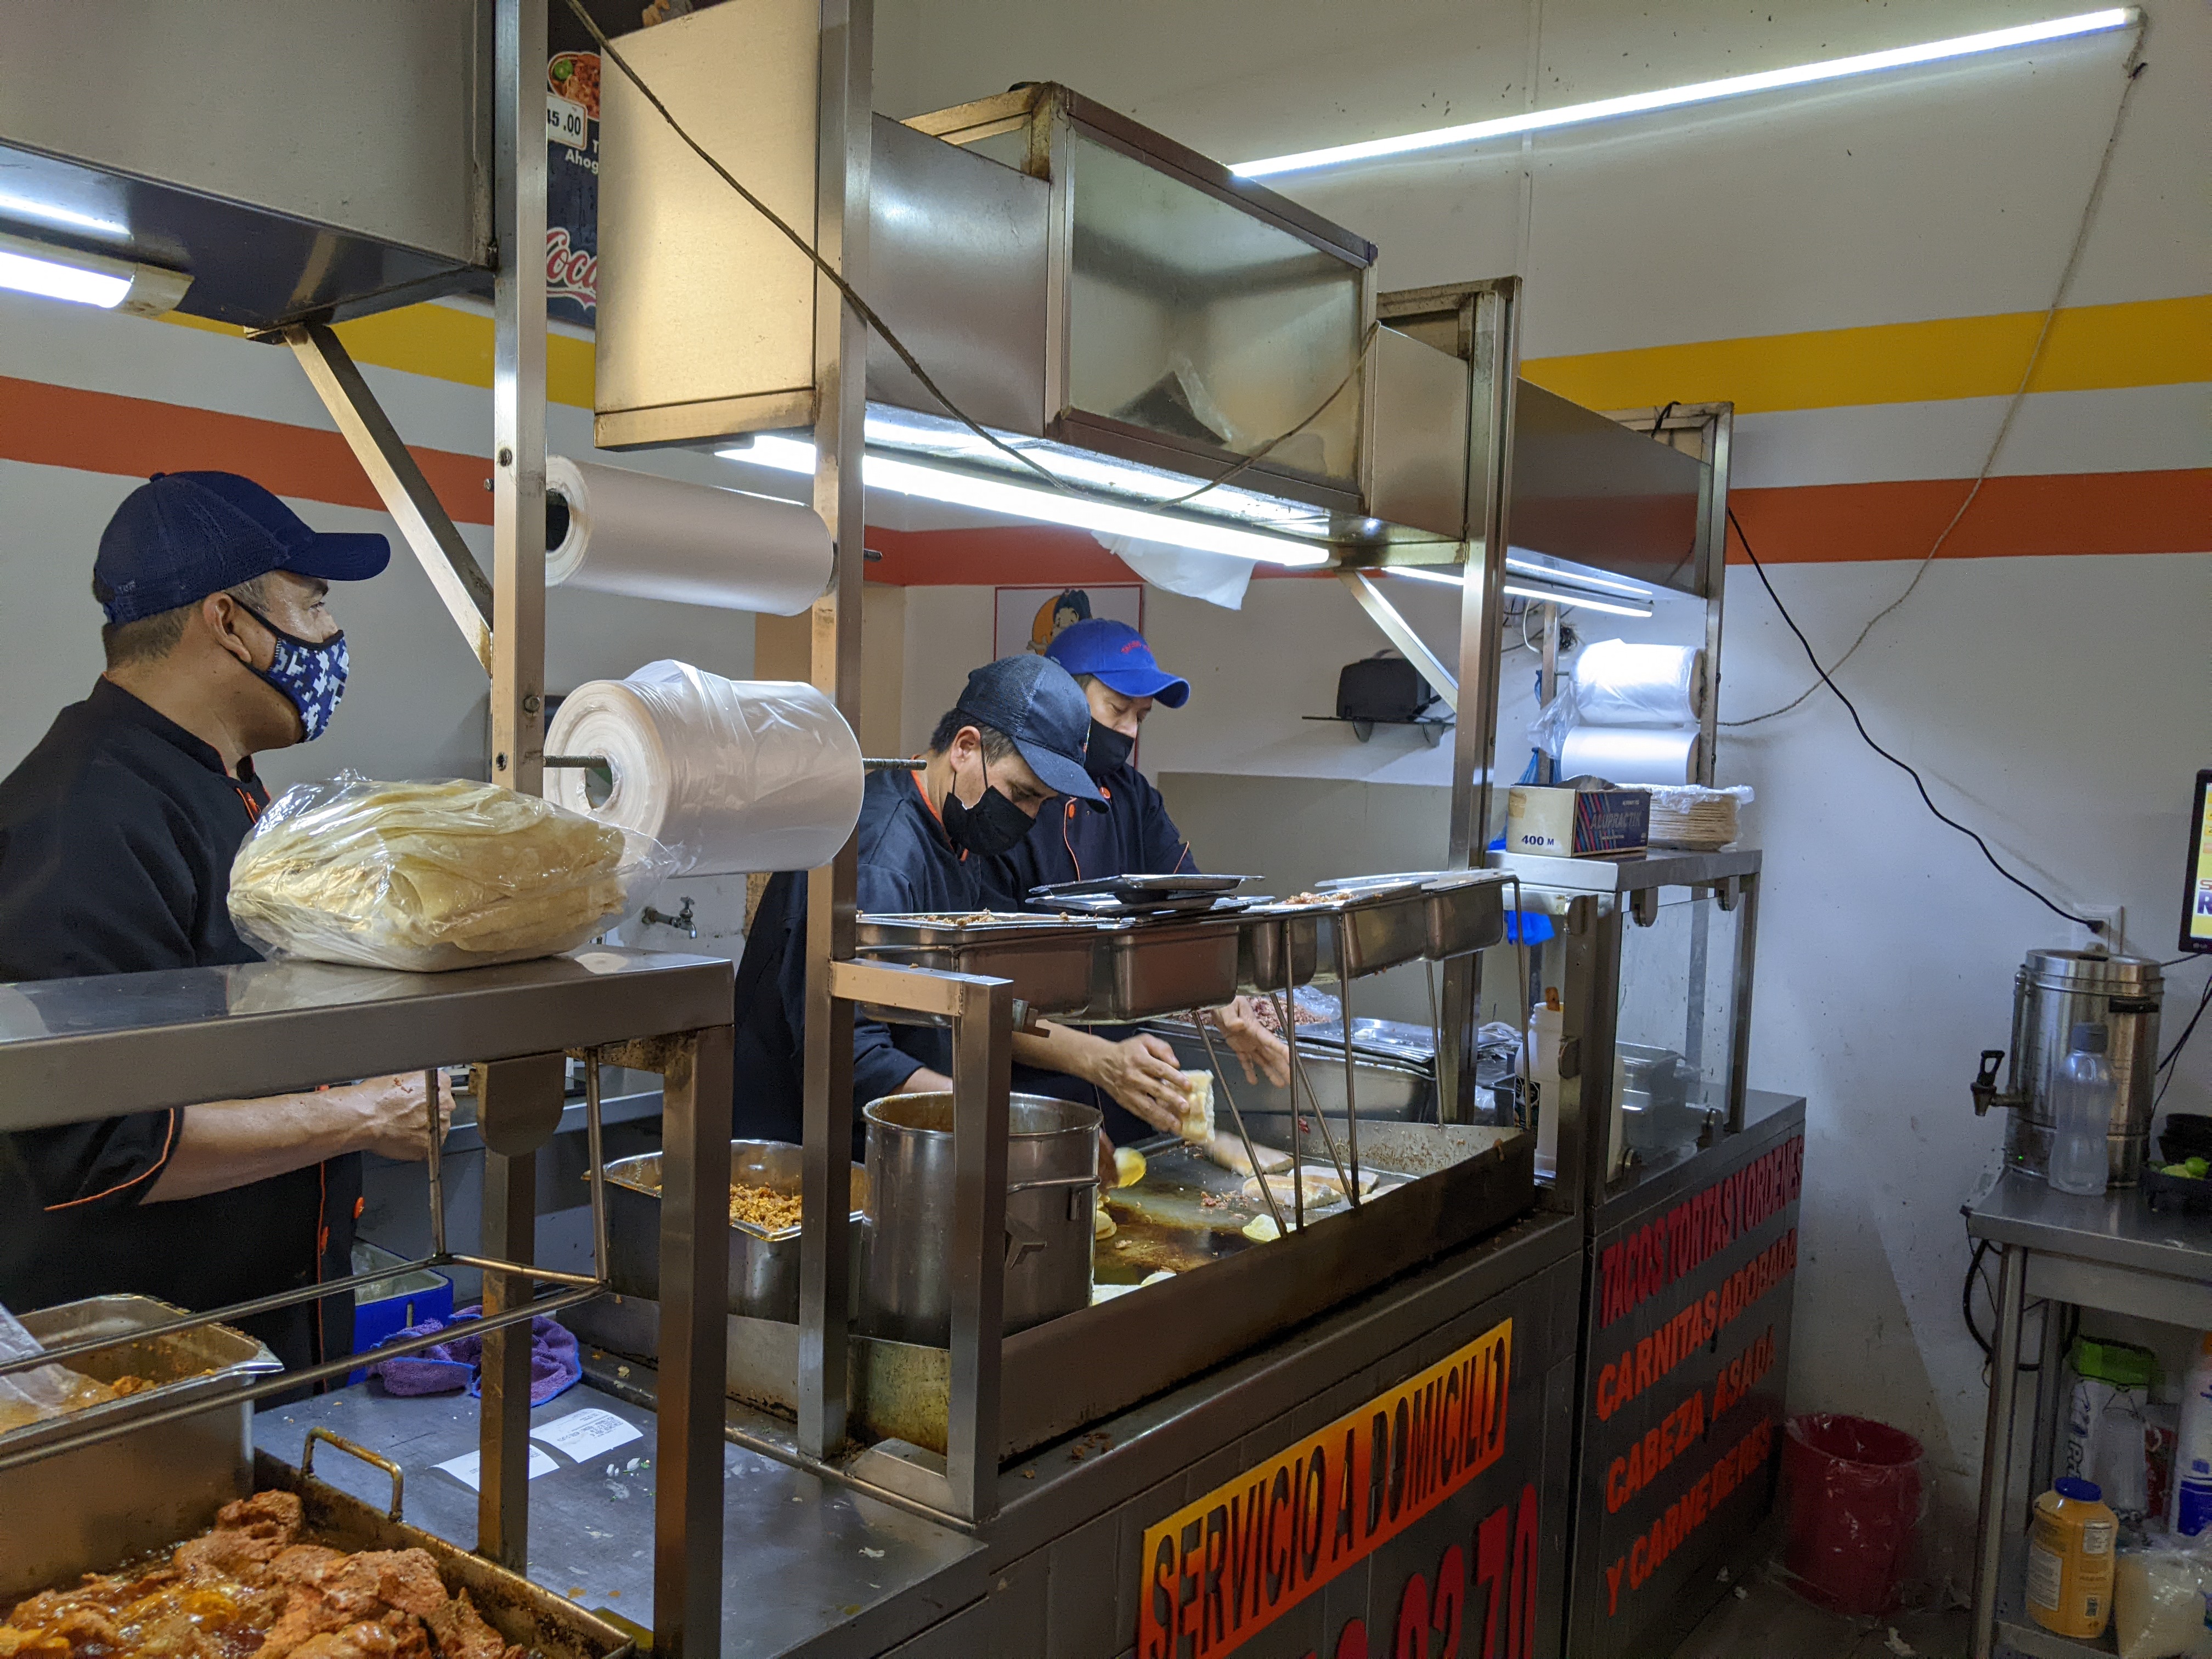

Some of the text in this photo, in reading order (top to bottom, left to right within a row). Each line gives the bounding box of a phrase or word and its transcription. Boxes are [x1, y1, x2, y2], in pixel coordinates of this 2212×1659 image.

[565, 149, 599, 174] Ahog
[1521, 834, 1544, 846] 400
[1596, 1228, 1797, 1422] CARNITAS ADOBADA
[1600, 1135, 1805, 1329] TACOS TORTAS Y ORDENES
[1150, 1336, 1506, 1659] SERVICIO A DOMICILIO
[1606, 1324, 1776, 1514] CABEZA ASADA
[1605, 1555, 1626, 1618] Y
[1628, 1471, 1711, 1590] CARNE
